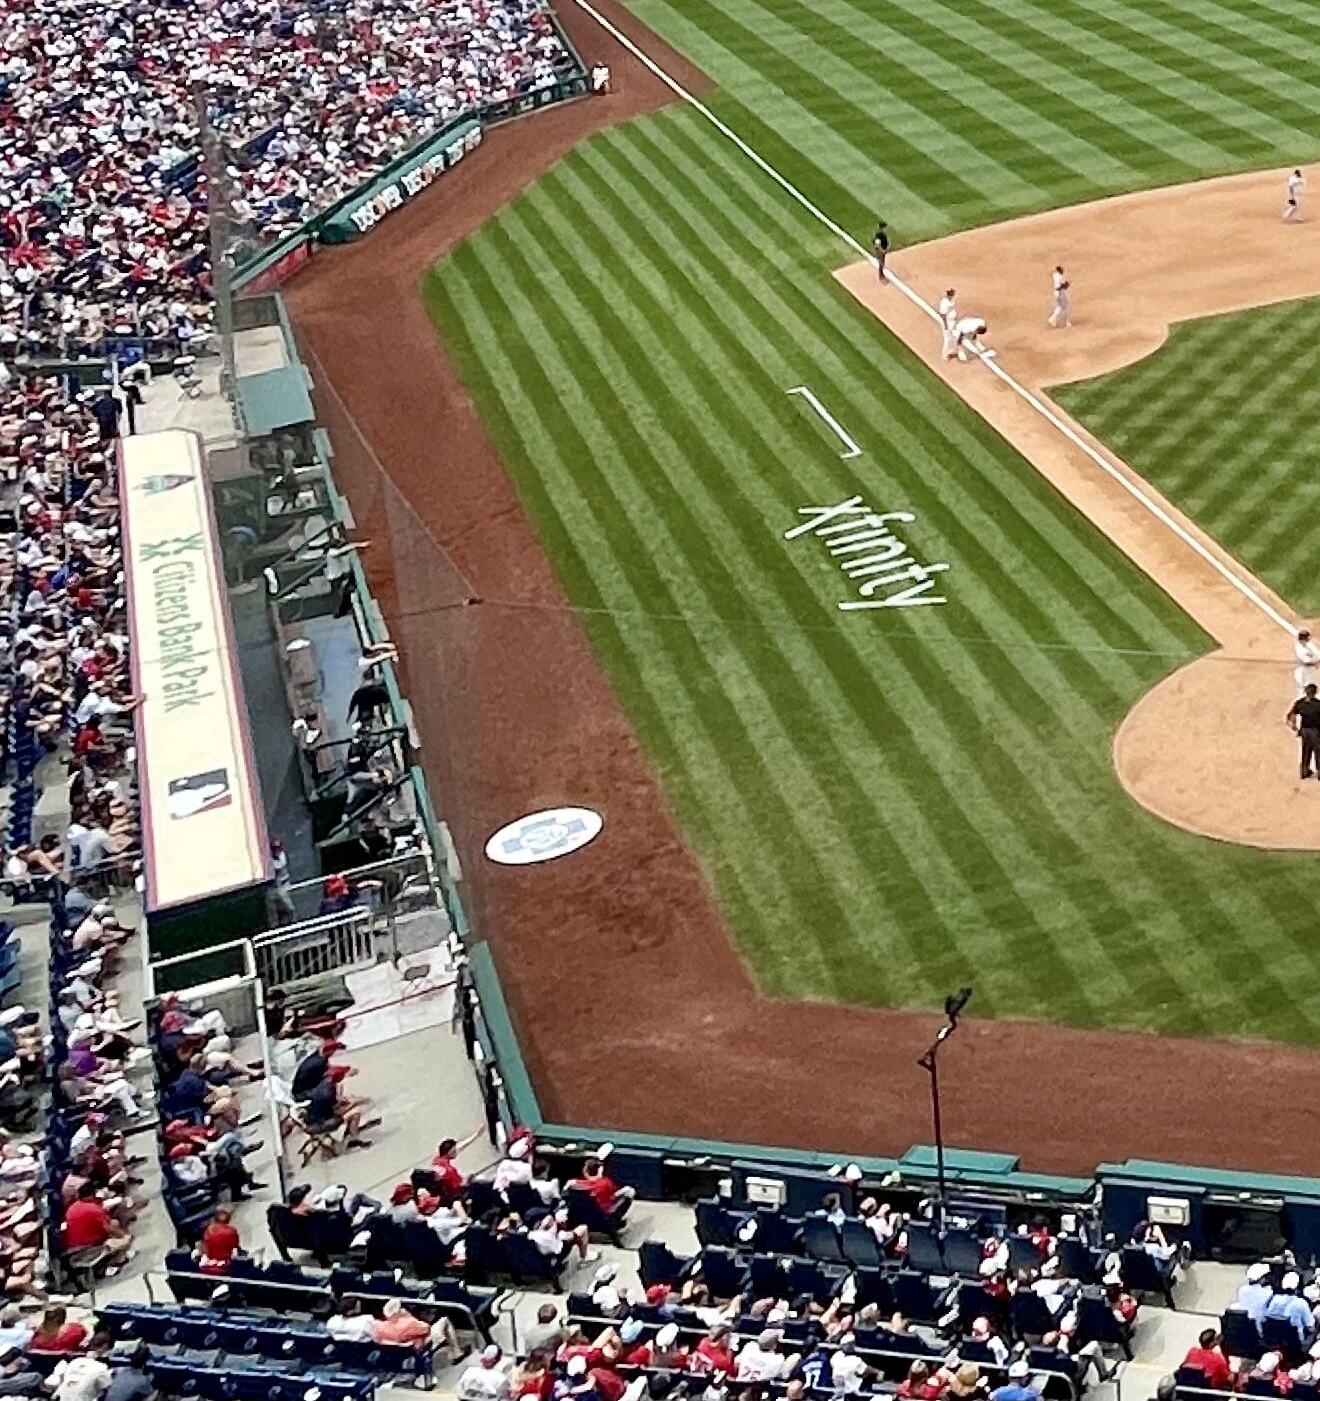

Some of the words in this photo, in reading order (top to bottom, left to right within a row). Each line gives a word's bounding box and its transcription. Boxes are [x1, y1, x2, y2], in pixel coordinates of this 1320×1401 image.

[784, 495, 950, 611] xfinity
[152, 560, 197, 631] Citizens
[157, 621, 204, 669] Bank
[162, 664, 216, 714] Park
